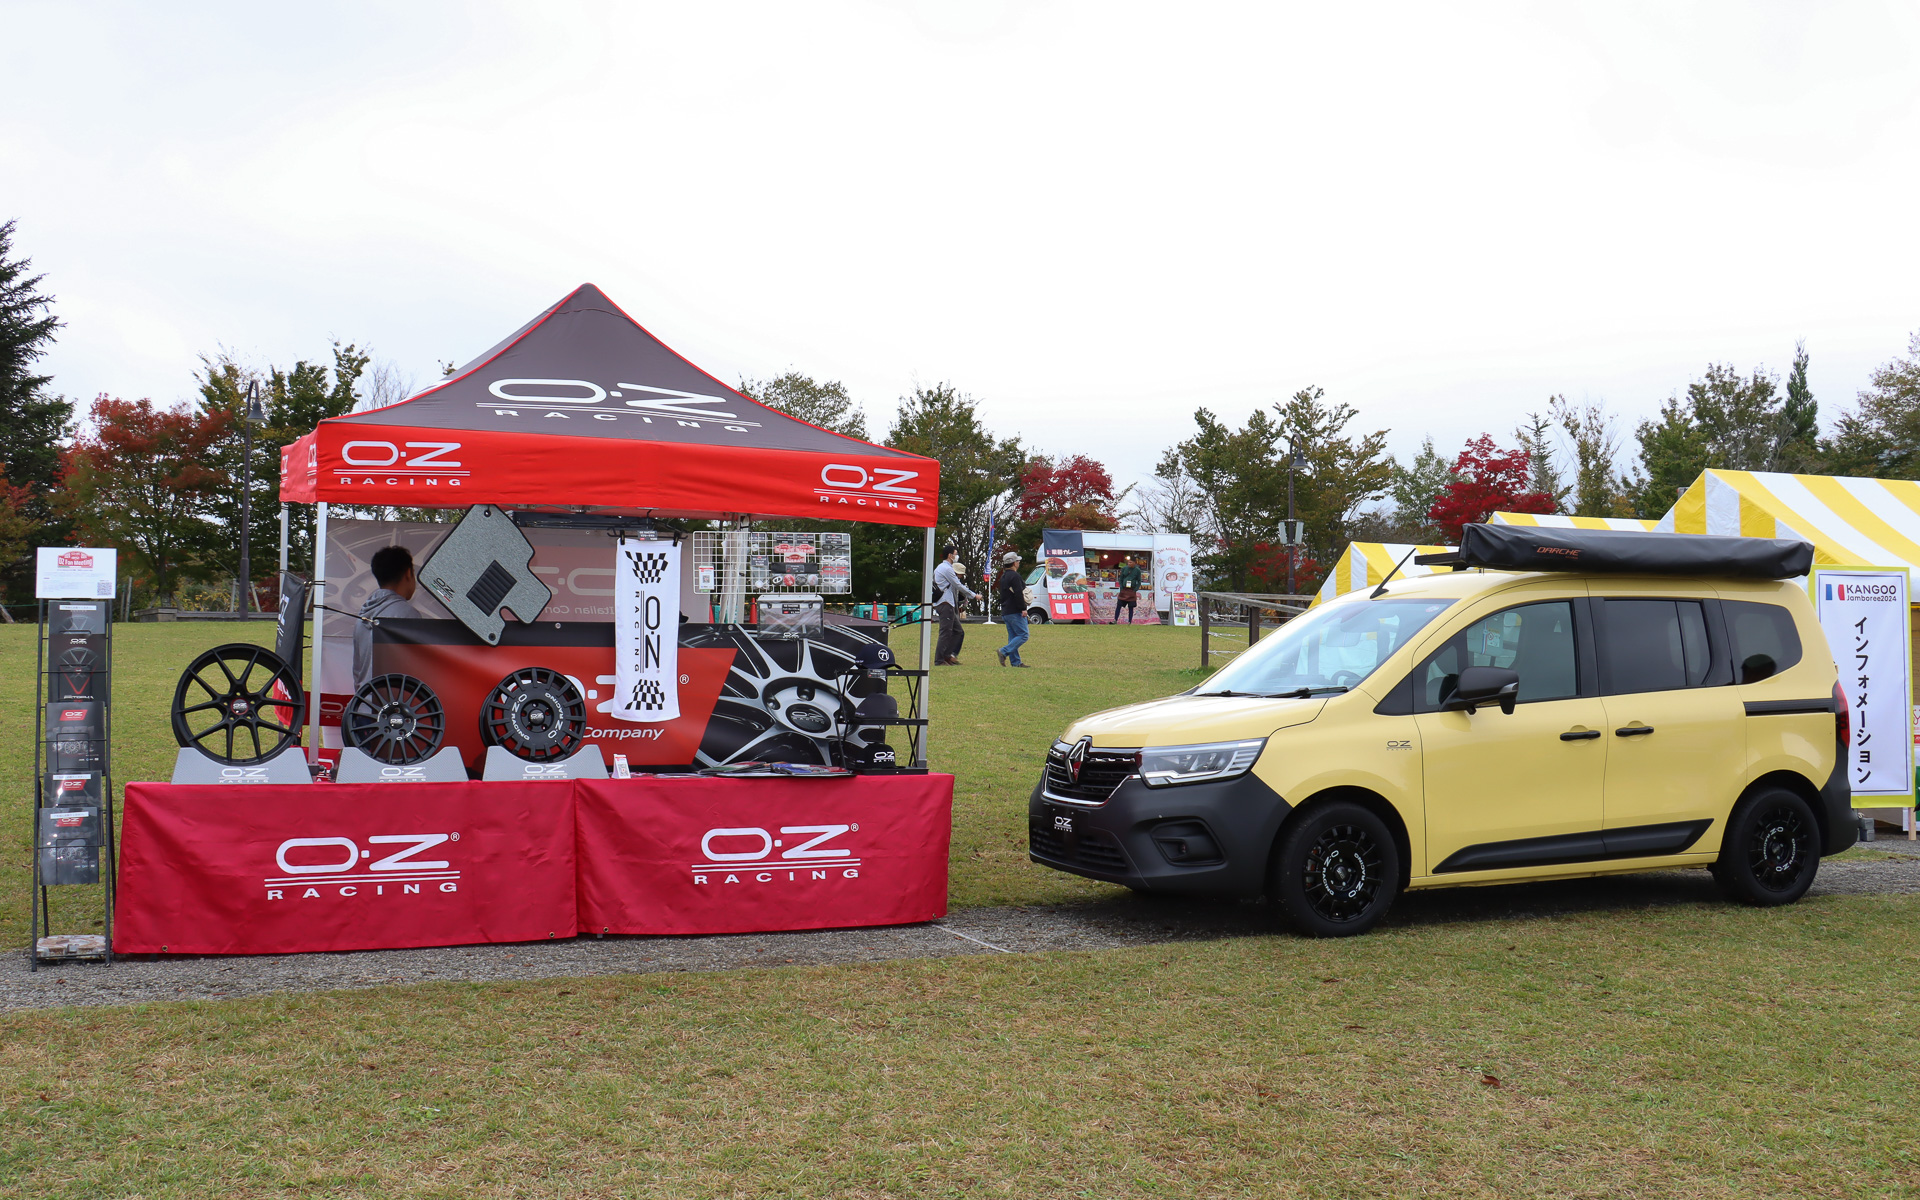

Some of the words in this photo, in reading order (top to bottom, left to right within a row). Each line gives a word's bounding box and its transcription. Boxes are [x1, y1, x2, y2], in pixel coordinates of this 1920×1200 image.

[495, 409, 749, 432] RACING
[340, 477, 461, 486] RACING
[820, 496, 917, 510] RACING
[1537, 546, 1581, 556] DARCHE
[1846, 584, 1897, 595] KANGOO
[545, 692, 564, 719] RACING
[1854, 616, 1872, 784] インフォメーション
[511, 713, 530, 740] RACING
[583, 726, 664, 740] Company
[693, 869, 860, 884] RACING
[267, 882, 458, 900] RACING
